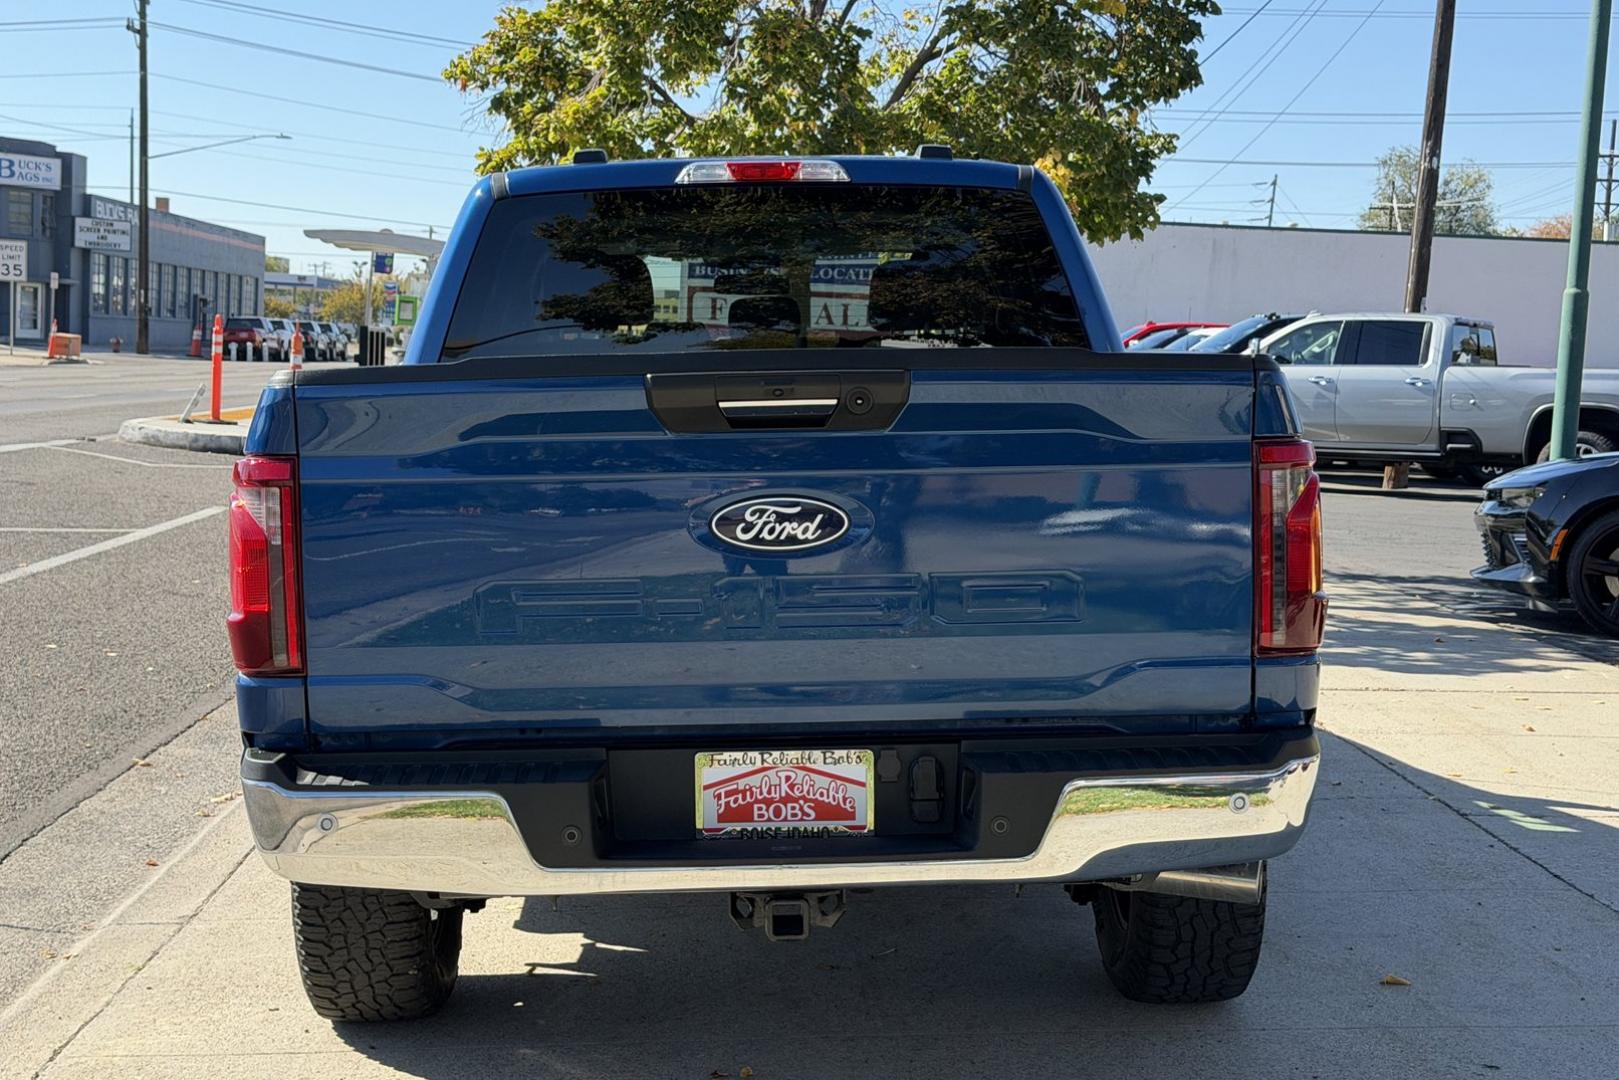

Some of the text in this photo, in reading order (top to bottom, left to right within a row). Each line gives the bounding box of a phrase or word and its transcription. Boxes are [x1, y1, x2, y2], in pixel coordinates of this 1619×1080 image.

[1, 263, 23, 277] 35
[736, 504, 824, 543] Ford
[708, 751, 863, 768] Fairly Reliable Bob's
[713, 769, 856, 814] Fairly Reliable
[753, 801, 816, 821] BOB'S
[740, 826, 831, 840] BOISE IDAHO
